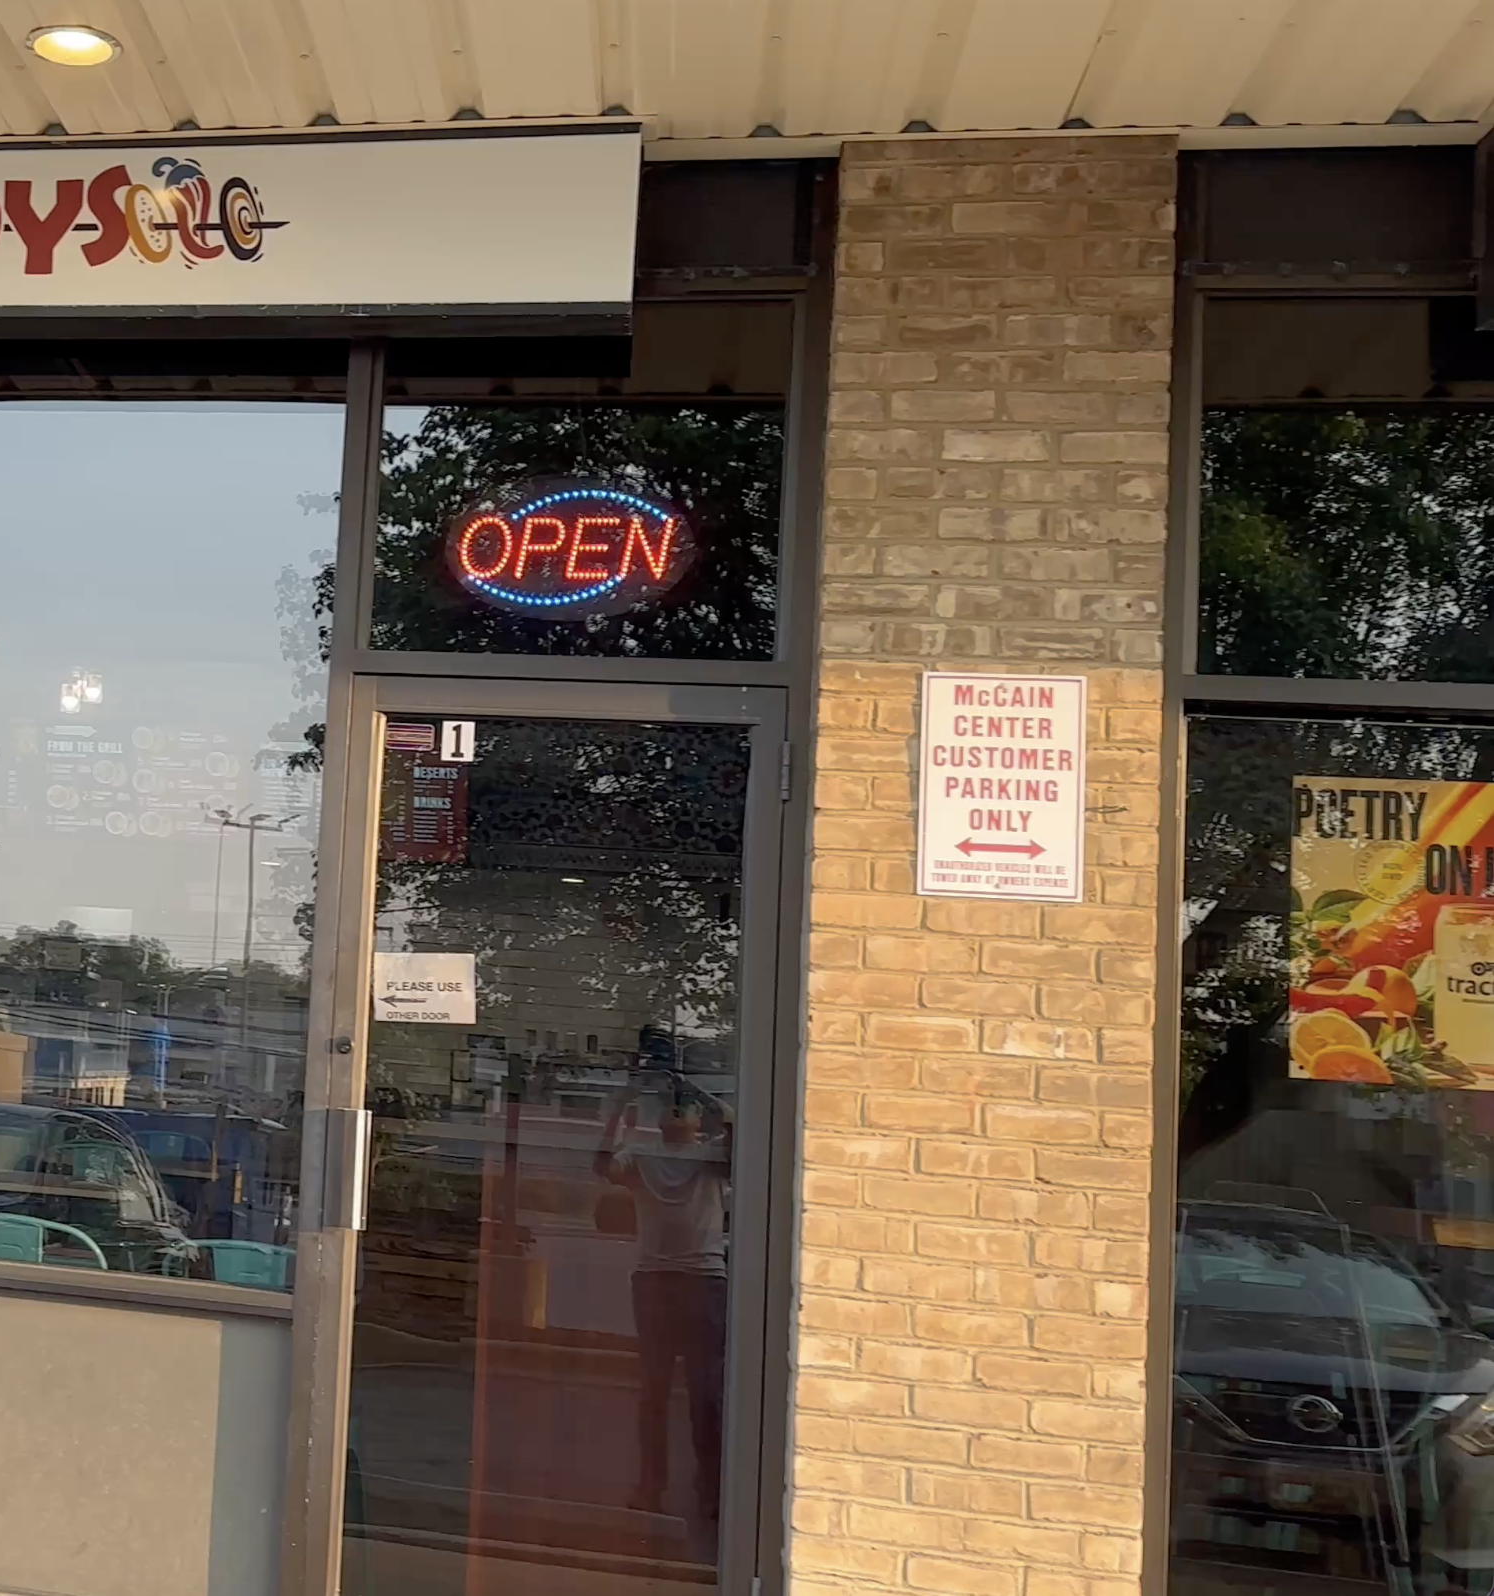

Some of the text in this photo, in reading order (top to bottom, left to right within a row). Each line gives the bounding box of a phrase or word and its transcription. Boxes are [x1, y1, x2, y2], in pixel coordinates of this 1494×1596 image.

[460, 516, 675, 581] OPEN
[954, 684, 1055, 708] McCAIN
[954, 715, 1053, 739] CENTER
[77, 741, 95, 752] THE
[451, 723, 464, 758] 1
[932, 745, 1073, 771] CUSTOMER
[944, 776, 1059, 802] PARKING
[968, 808, 1033, 832] ONLY
[1293, 786, 1427, 840] POETRY
[1426, 844, 1472, 896] ON
[386, 981, 463, 992] PLEASE USE
[1447, 975, 1494, 996] trac
[386, 1011, 450, 1021] OTHER DOOR
